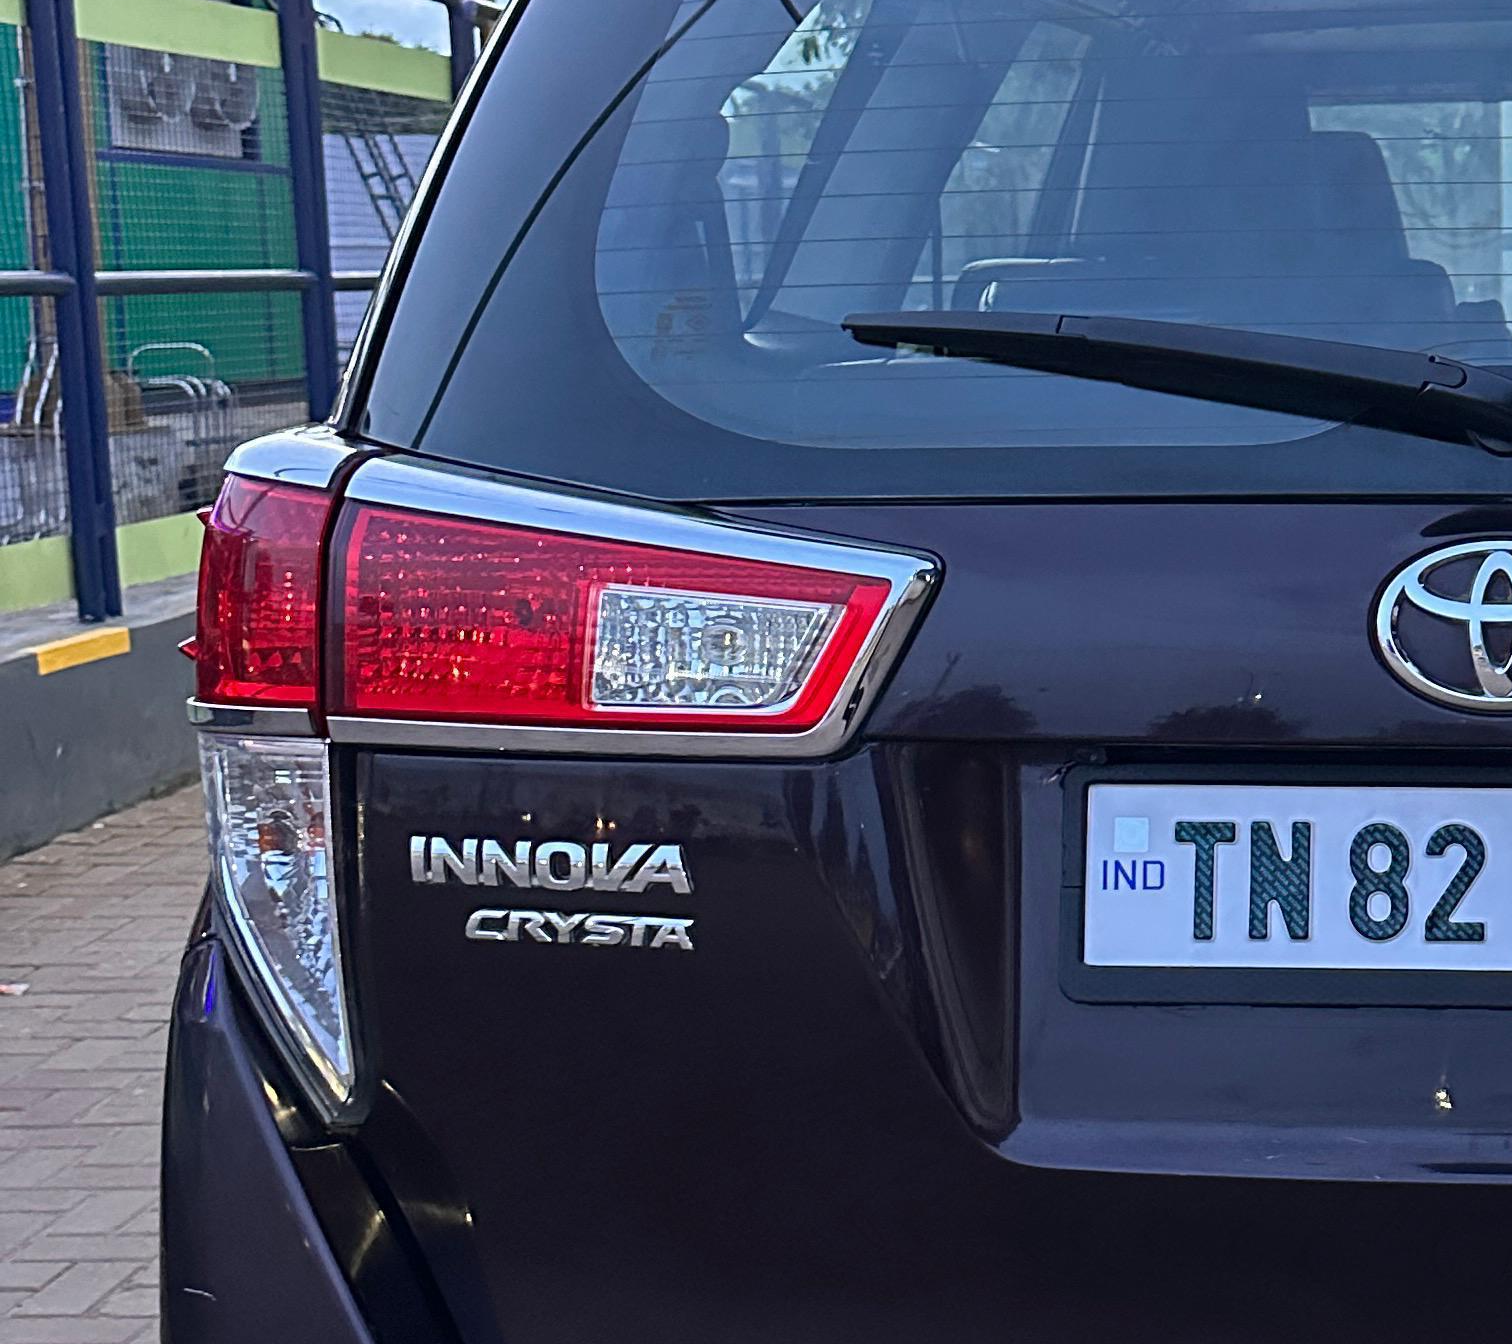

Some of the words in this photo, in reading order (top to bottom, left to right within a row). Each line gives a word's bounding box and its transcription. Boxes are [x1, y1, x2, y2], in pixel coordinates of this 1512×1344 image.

[409, 835, 694, 894] INNOVA
[1102, 859, 1165, 890] IND
[1175, 821, 1311, 940] TN
[1349, 822, 1486, 942] 82
[465, 908, 694, 950] CRYSTA
